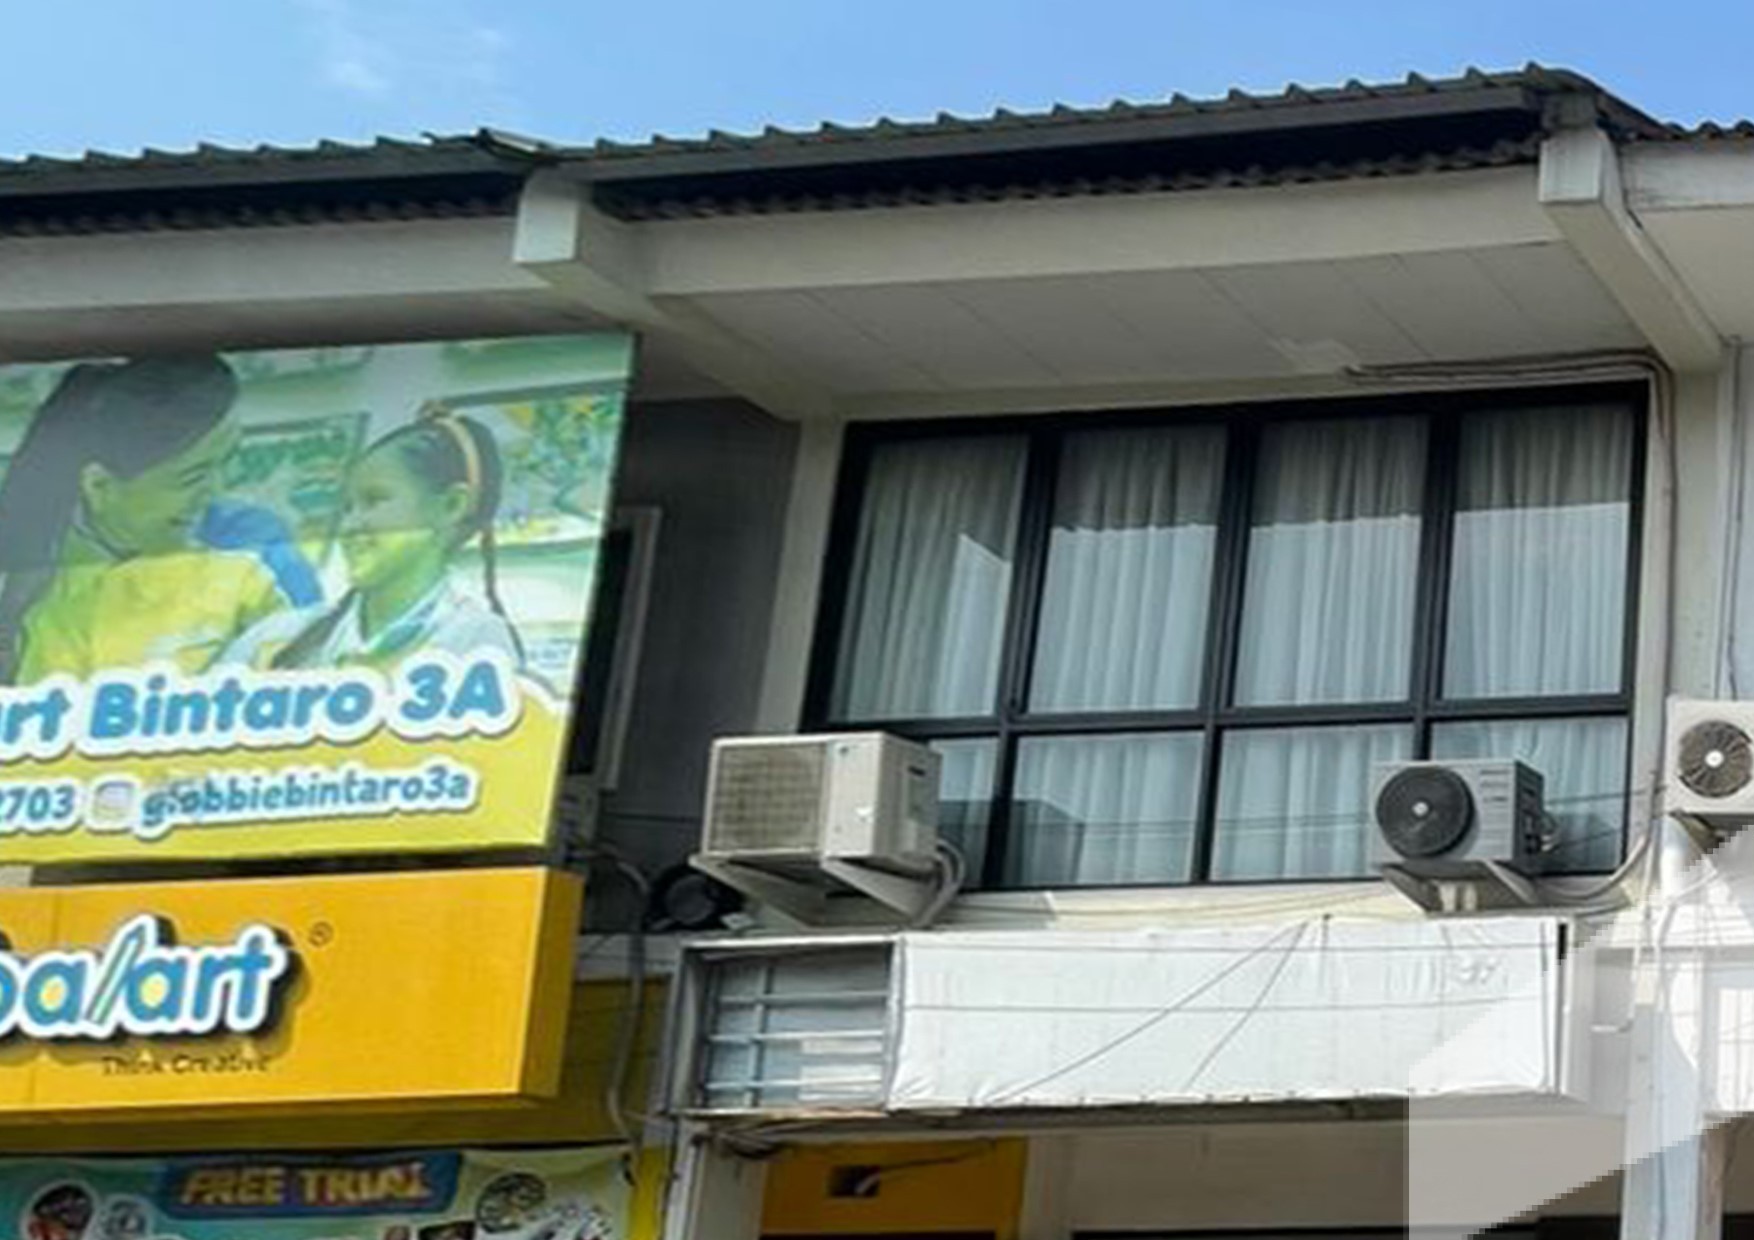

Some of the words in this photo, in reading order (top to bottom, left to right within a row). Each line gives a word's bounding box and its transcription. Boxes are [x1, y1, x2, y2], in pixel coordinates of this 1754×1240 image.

[0, 688, 72, 745] rt
[89, 676, 374, 739] Bintaro
[400, 661, 504, 721] 3A
[0, 784, 76, 821] 703
[181, 1165, 285, 1205] FREE
